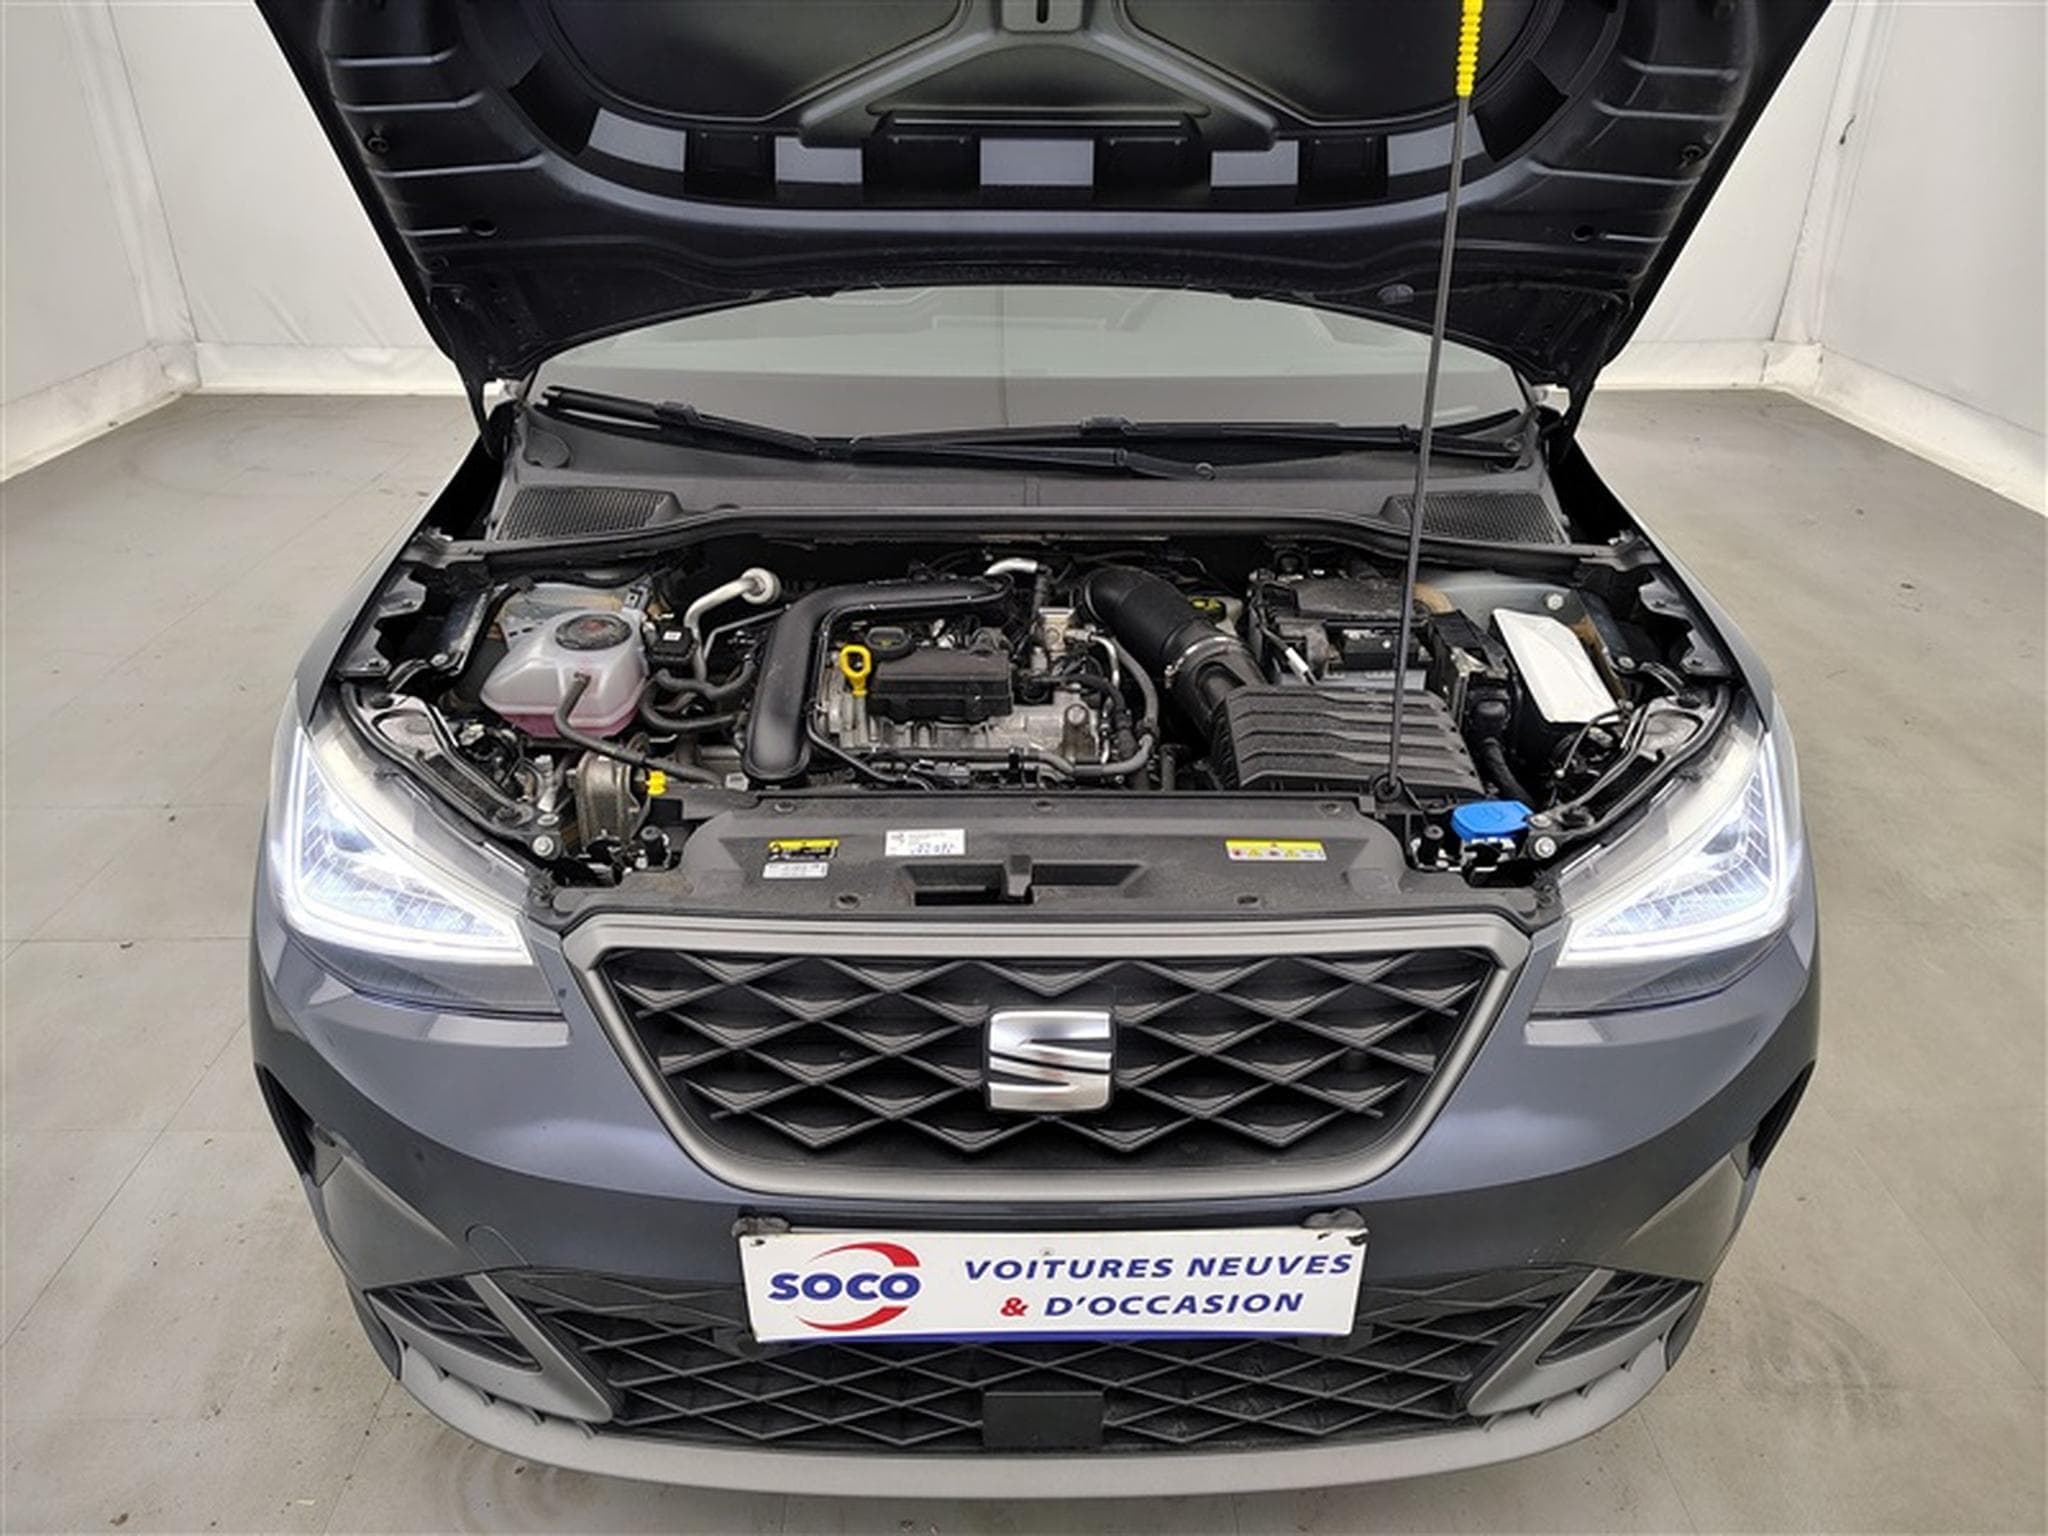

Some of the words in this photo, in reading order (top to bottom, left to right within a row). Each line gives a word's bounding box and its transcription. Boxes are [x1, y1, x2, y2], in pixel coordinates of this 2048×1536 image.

[965, 1258, 1173, 1281] VOITURES
[1187, 1254, 1353, 1277] NEUVES
[768, 1272, 921, 1301] SOCO
[1000, 1296, 1029, 1318] &
[1044, 1293, 1303, 1317] D'OCCASION
